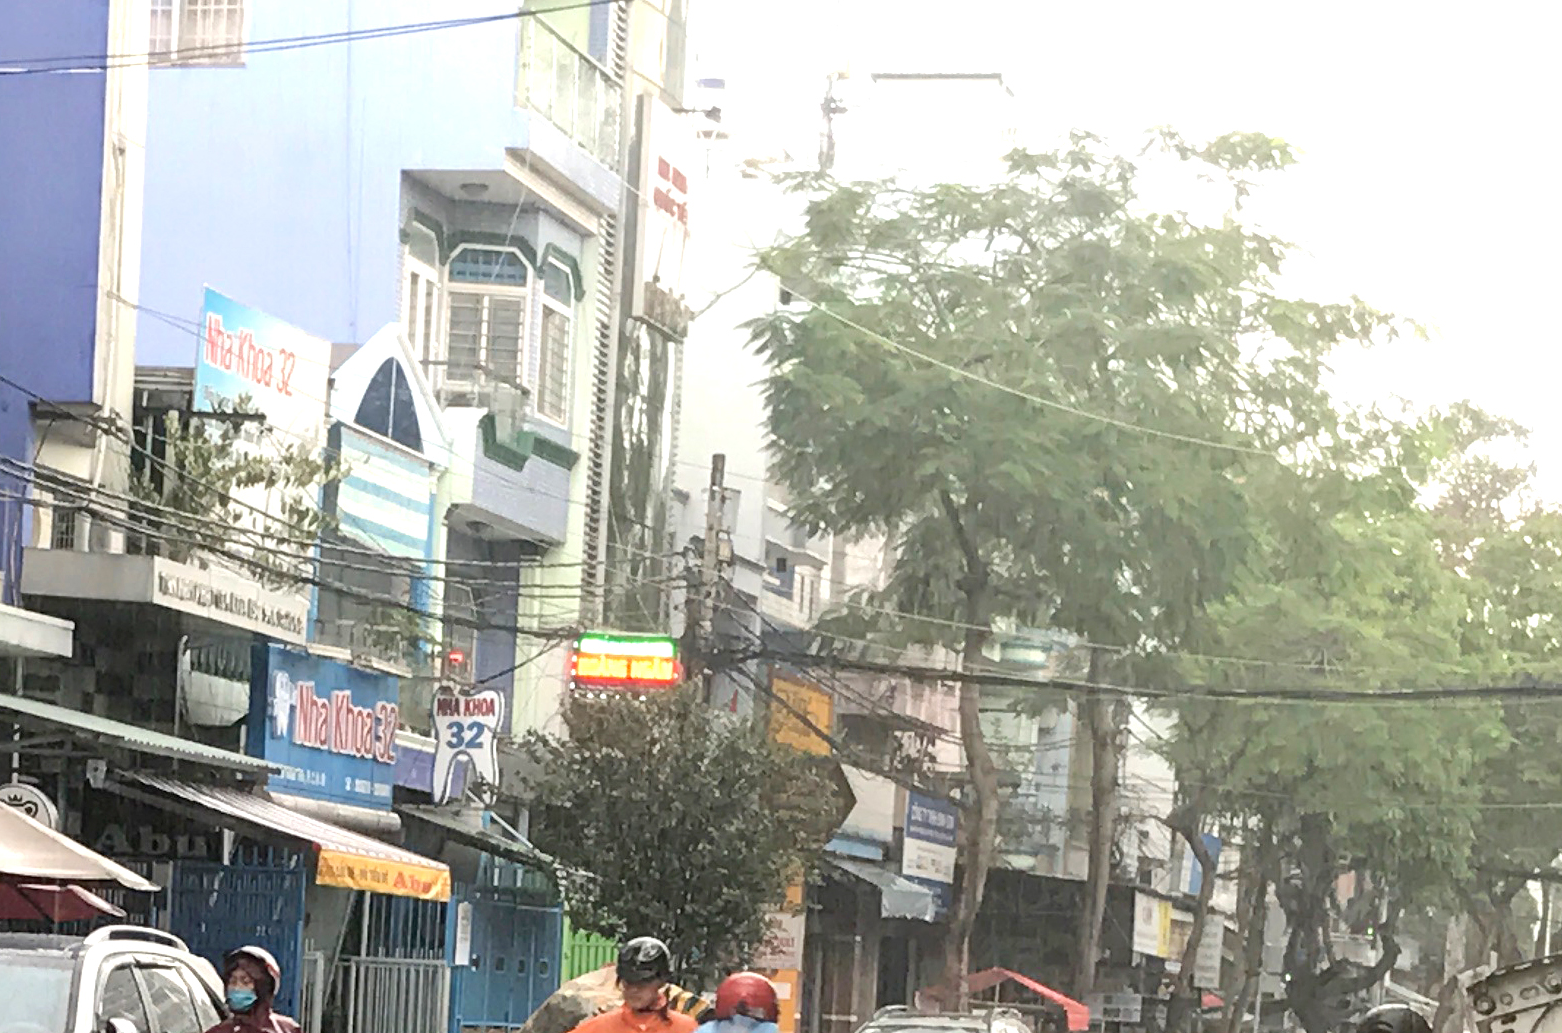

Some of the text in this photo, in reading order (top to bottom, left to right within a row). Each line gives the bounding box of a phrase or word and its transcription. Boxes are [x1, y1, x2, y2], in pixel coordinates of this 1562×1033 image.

[205, 314, 296, 397] Nha Khoa 32
[437, 697, 496, 717] NHA KHOA
[294, 680, 399, 765] Nha Khoa 32
[446, 721, 486, 749] 32
[393, 871, 433, 894] Abu
